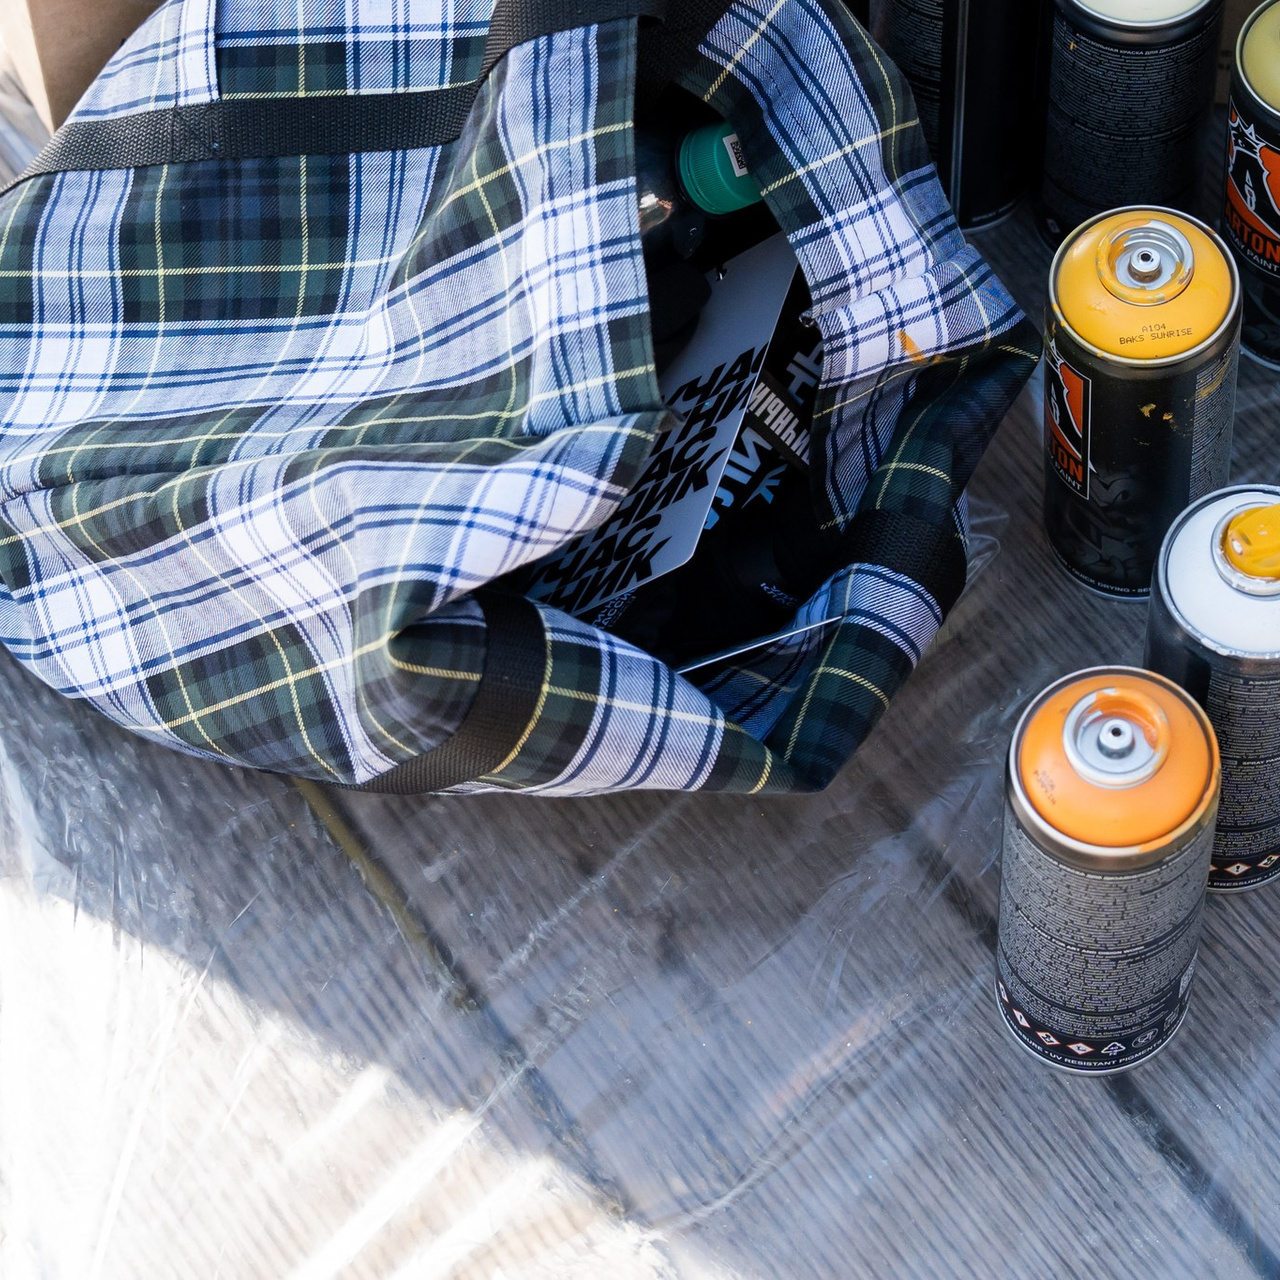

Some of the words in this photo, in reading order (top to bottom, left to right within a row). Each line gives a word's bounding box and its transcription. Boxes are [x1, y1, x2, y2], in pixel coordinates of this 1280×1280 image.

[1247, 248, 1280, 273] PAINT
[1119, 334, 1145, 345] BAKS
[1150, 328, 1193, 341] SUNRISE
[1141, 322, 1166, 333] A104
[1072, 566, 1098, 586] QUICK
[1098, 581, 1130, 593] DRYING
[1048, 1052, 1063, 1061] UV
[1064, 1058, 1118, 1067] RESISTANT
[1118, 1039, 1163, 1064] PIGMENTS
